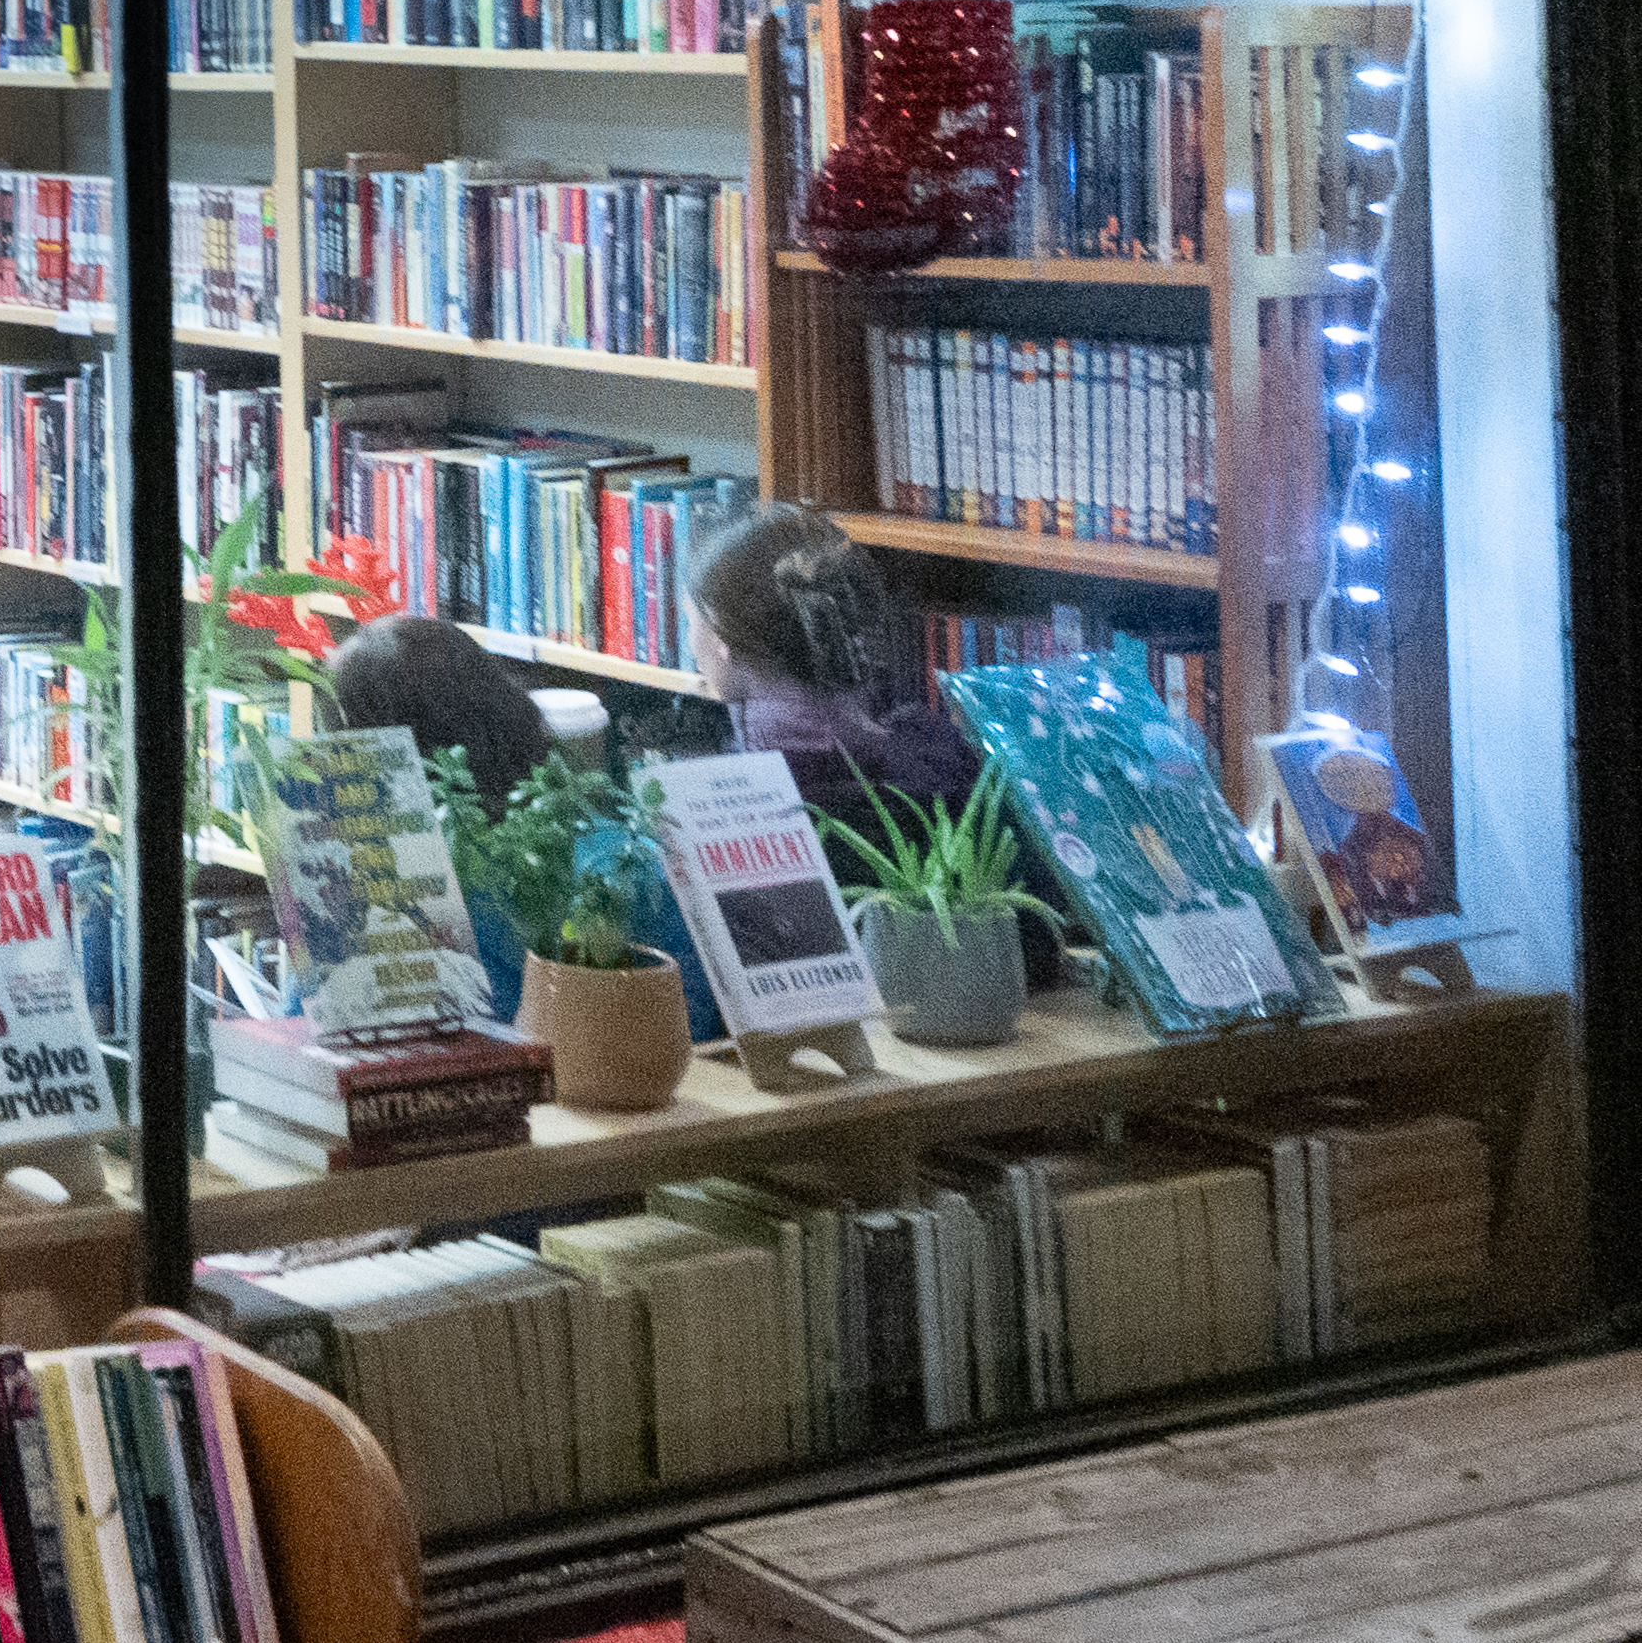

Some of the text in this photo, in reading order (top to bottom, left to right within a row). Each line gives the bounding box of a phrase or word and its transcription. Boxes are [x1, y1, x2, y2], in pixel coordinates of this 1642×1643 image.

[695, 828, 814, 877] IMMINENT
[747, 960, 866, 998] LUIS ELIZONDO
[1, 1042, 91, 1084] Solve
